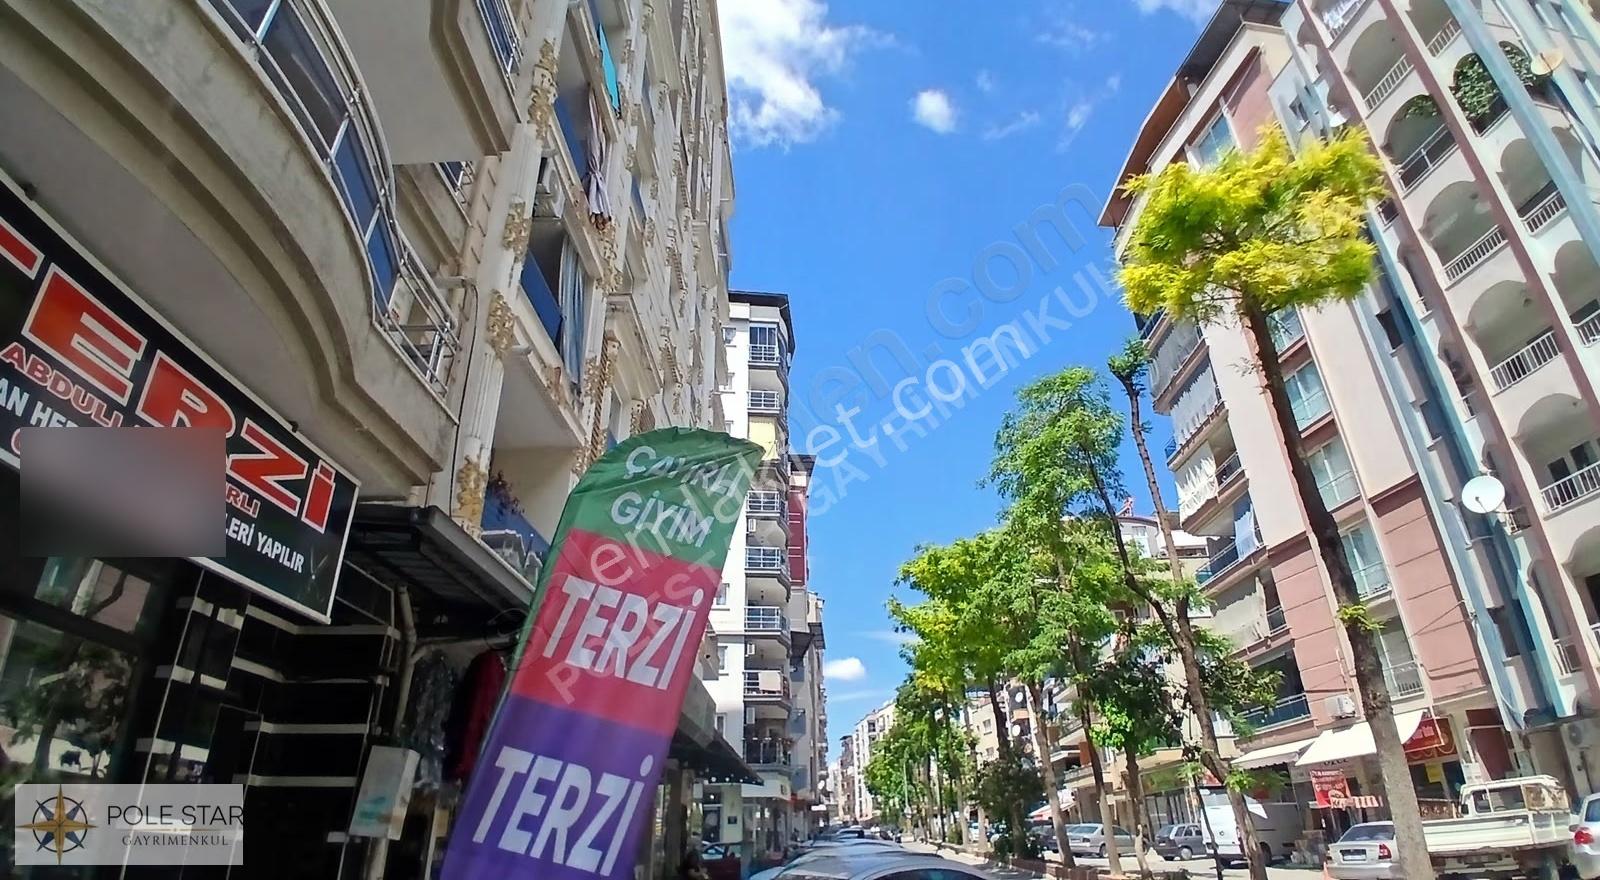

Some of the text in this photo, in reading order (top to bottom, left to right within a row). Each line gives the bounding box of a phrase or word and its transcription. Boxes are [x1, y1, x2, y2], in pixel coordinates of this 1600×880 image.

[257, 532, 305, 573] YAPILIR
[611, 490, 715, 548] GİYİM
[542, 574, 704, 690] TERZİ
[472, 745, 654, 877] TERZİ
